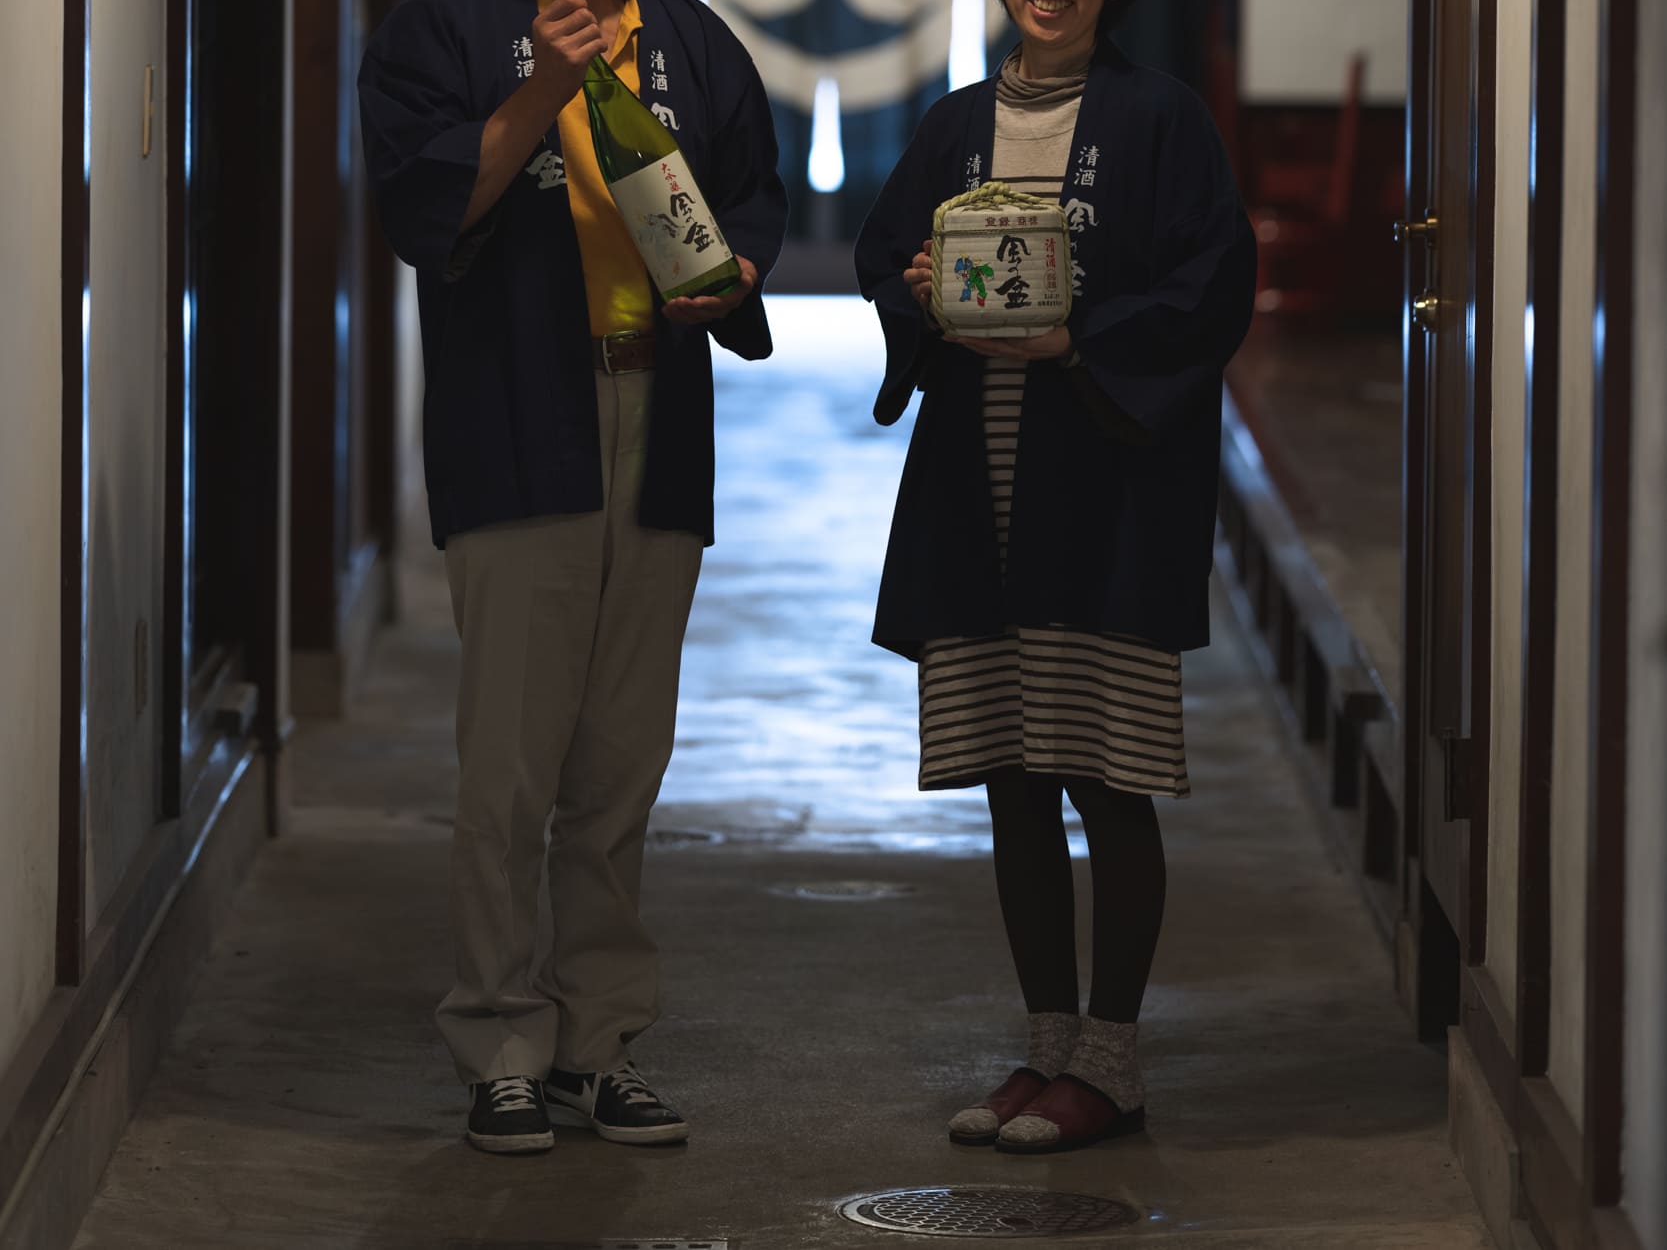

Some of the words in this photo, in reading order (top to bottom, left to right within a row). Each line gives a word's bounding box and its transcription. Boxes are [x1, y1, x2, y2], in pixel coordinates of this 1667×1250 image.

[512, 36, 535, 78] 清酒
[650, 49, 668, 92] 清酒
[965, 154, 983, 192] 清酒
[1073, 145, 1101, 187] 清酒
[1044, 238, 1056, 268] 清酒
